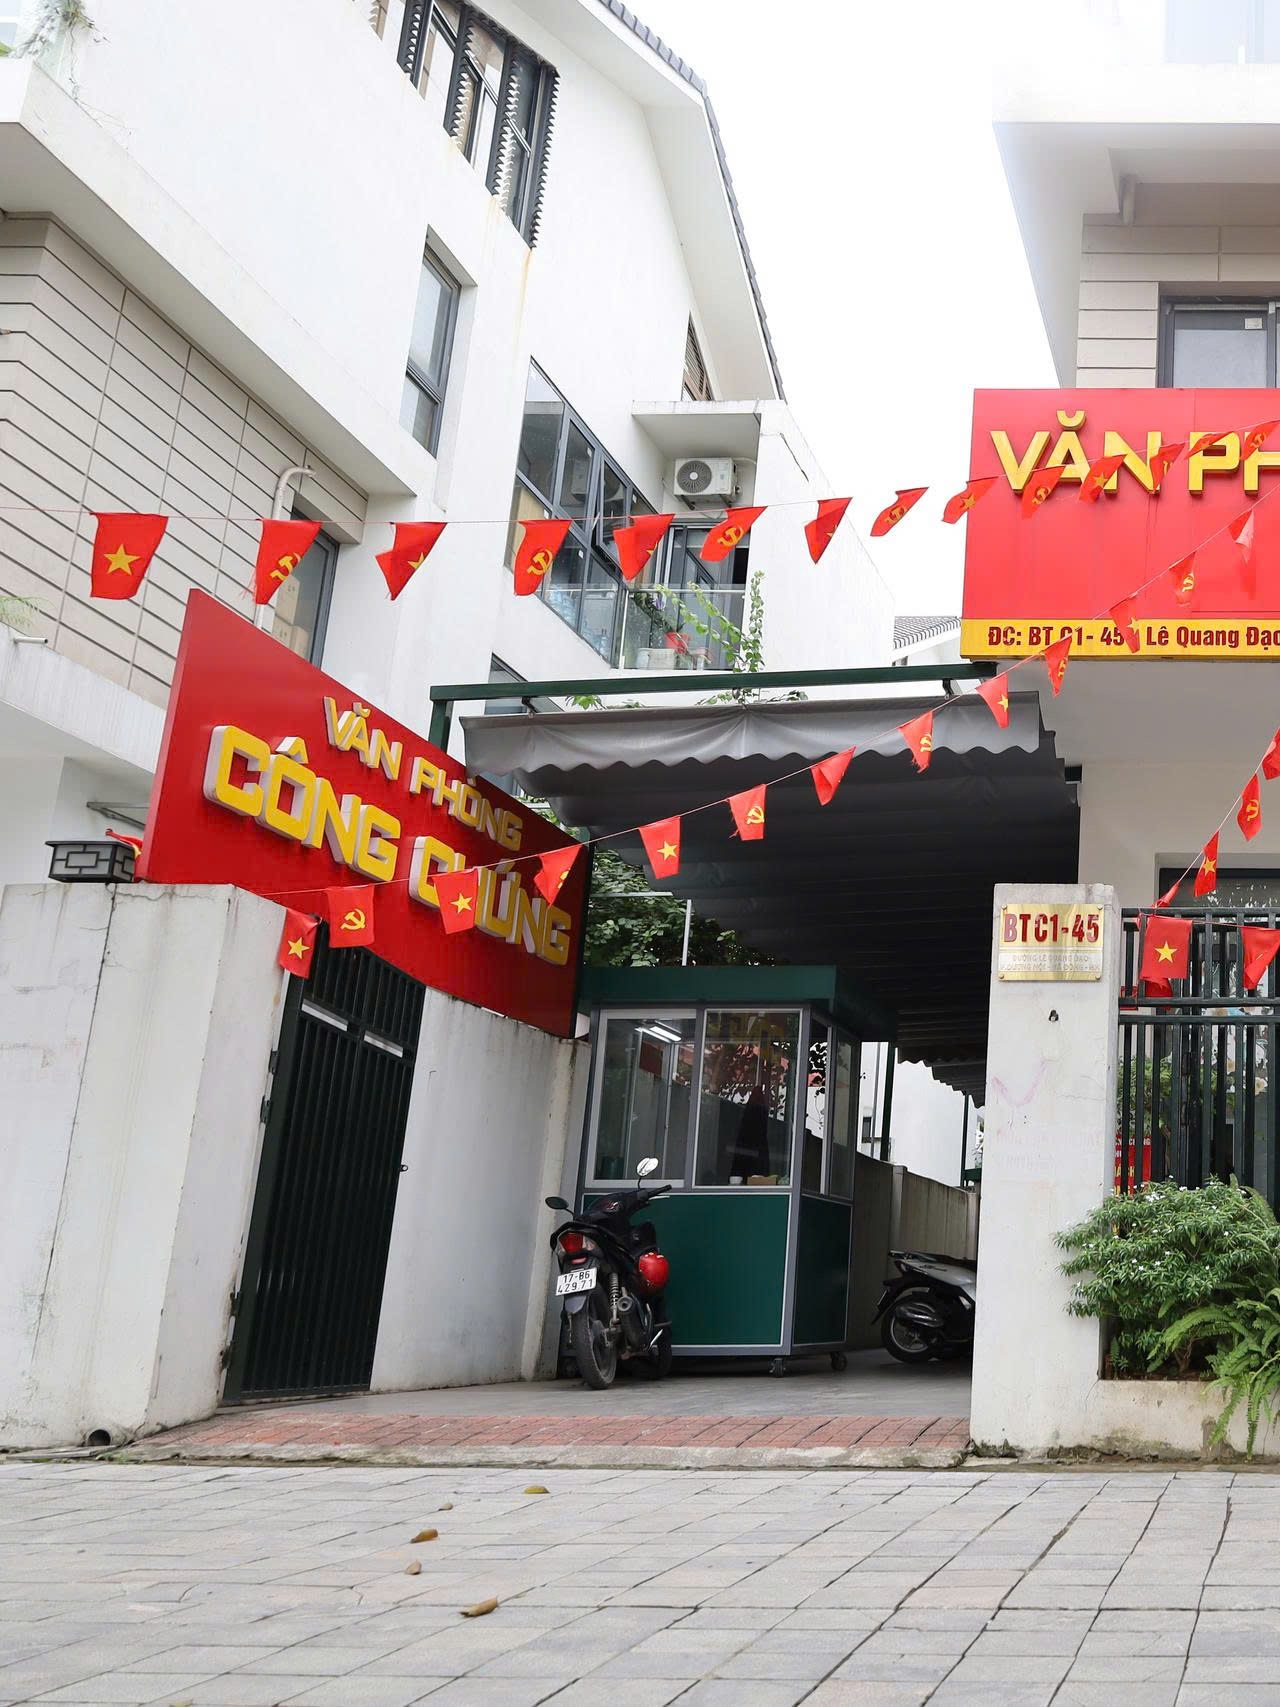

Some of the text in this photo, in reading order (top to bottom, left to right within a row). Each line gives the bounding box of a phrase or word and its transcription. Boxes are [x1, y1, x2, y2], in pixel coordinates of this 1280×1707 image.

[990, 410, 1162, 495] VĂN
[988, 626, 1022, 646] ĐC:
[1028, 626, 1053, 646] BT
[1146, 626, 1169, 646] Lê
[1177, 626, 1240, 648] Quang
[203, 725, 401, 882] CÔNG
[324, 696, 523, 852] VĂN PHÒNG
